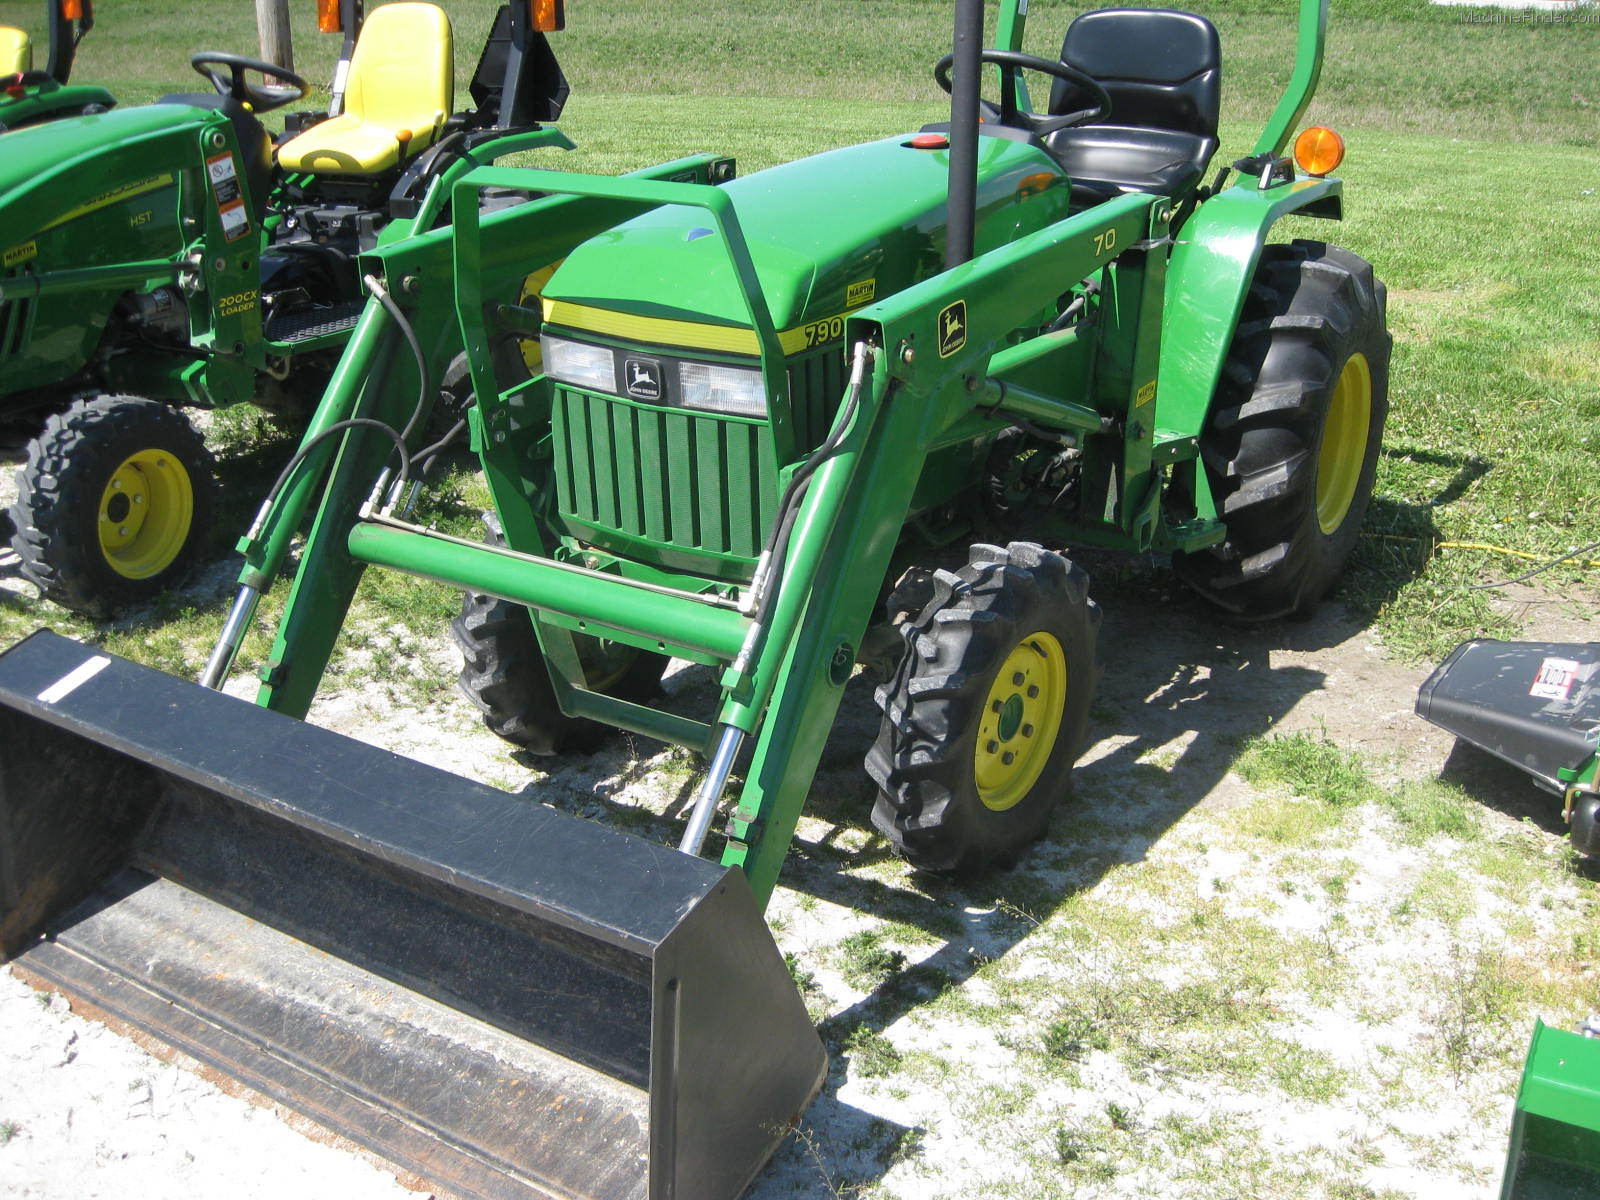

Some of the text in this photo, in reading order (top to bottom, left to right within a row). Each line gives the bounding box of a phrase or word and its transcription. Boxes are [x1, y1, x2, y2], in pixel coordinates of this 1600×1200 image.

[130, 209, 152, 227] HST
[1093, 228, 1116, 257] 70
[4, 246, 33, 261] MARTIN
[219, 290, 257, 308] 200CX
[848, 283, 874, 298] MARTIN
[221, 302, 255, 317] LOADER
[804, 316, 843, 347] 790
